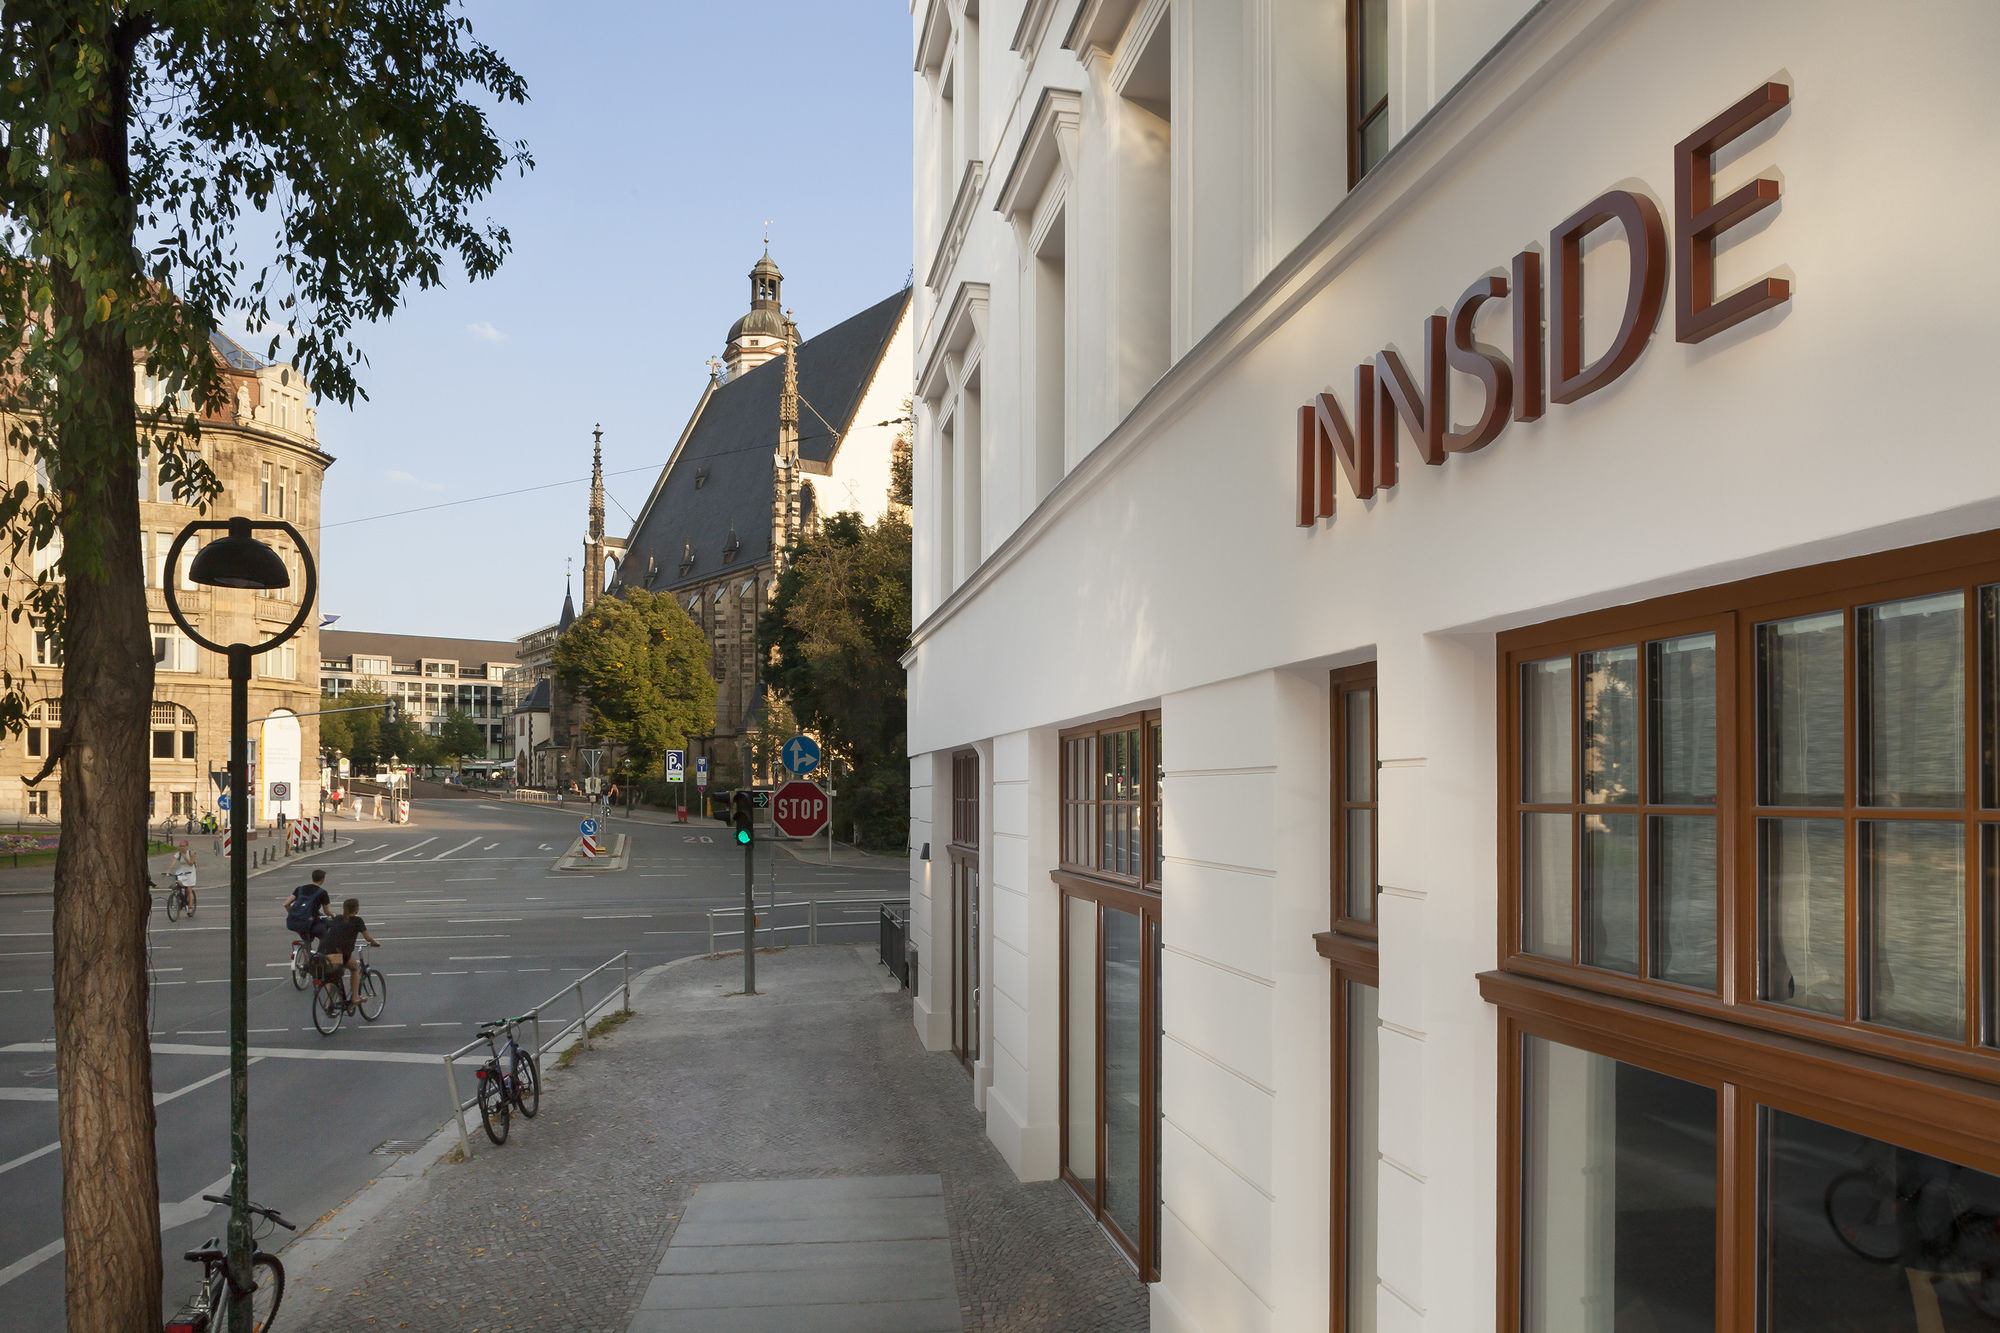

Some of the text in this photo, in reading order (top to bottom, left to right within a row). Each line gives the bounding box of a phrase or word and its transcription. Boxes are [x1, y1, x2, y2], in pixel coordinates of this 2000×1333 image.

[1296, 81, 1790, 528] INNSIDE
[669, 755, 678, 770] P
[778, 798, 823, 820] STOP
